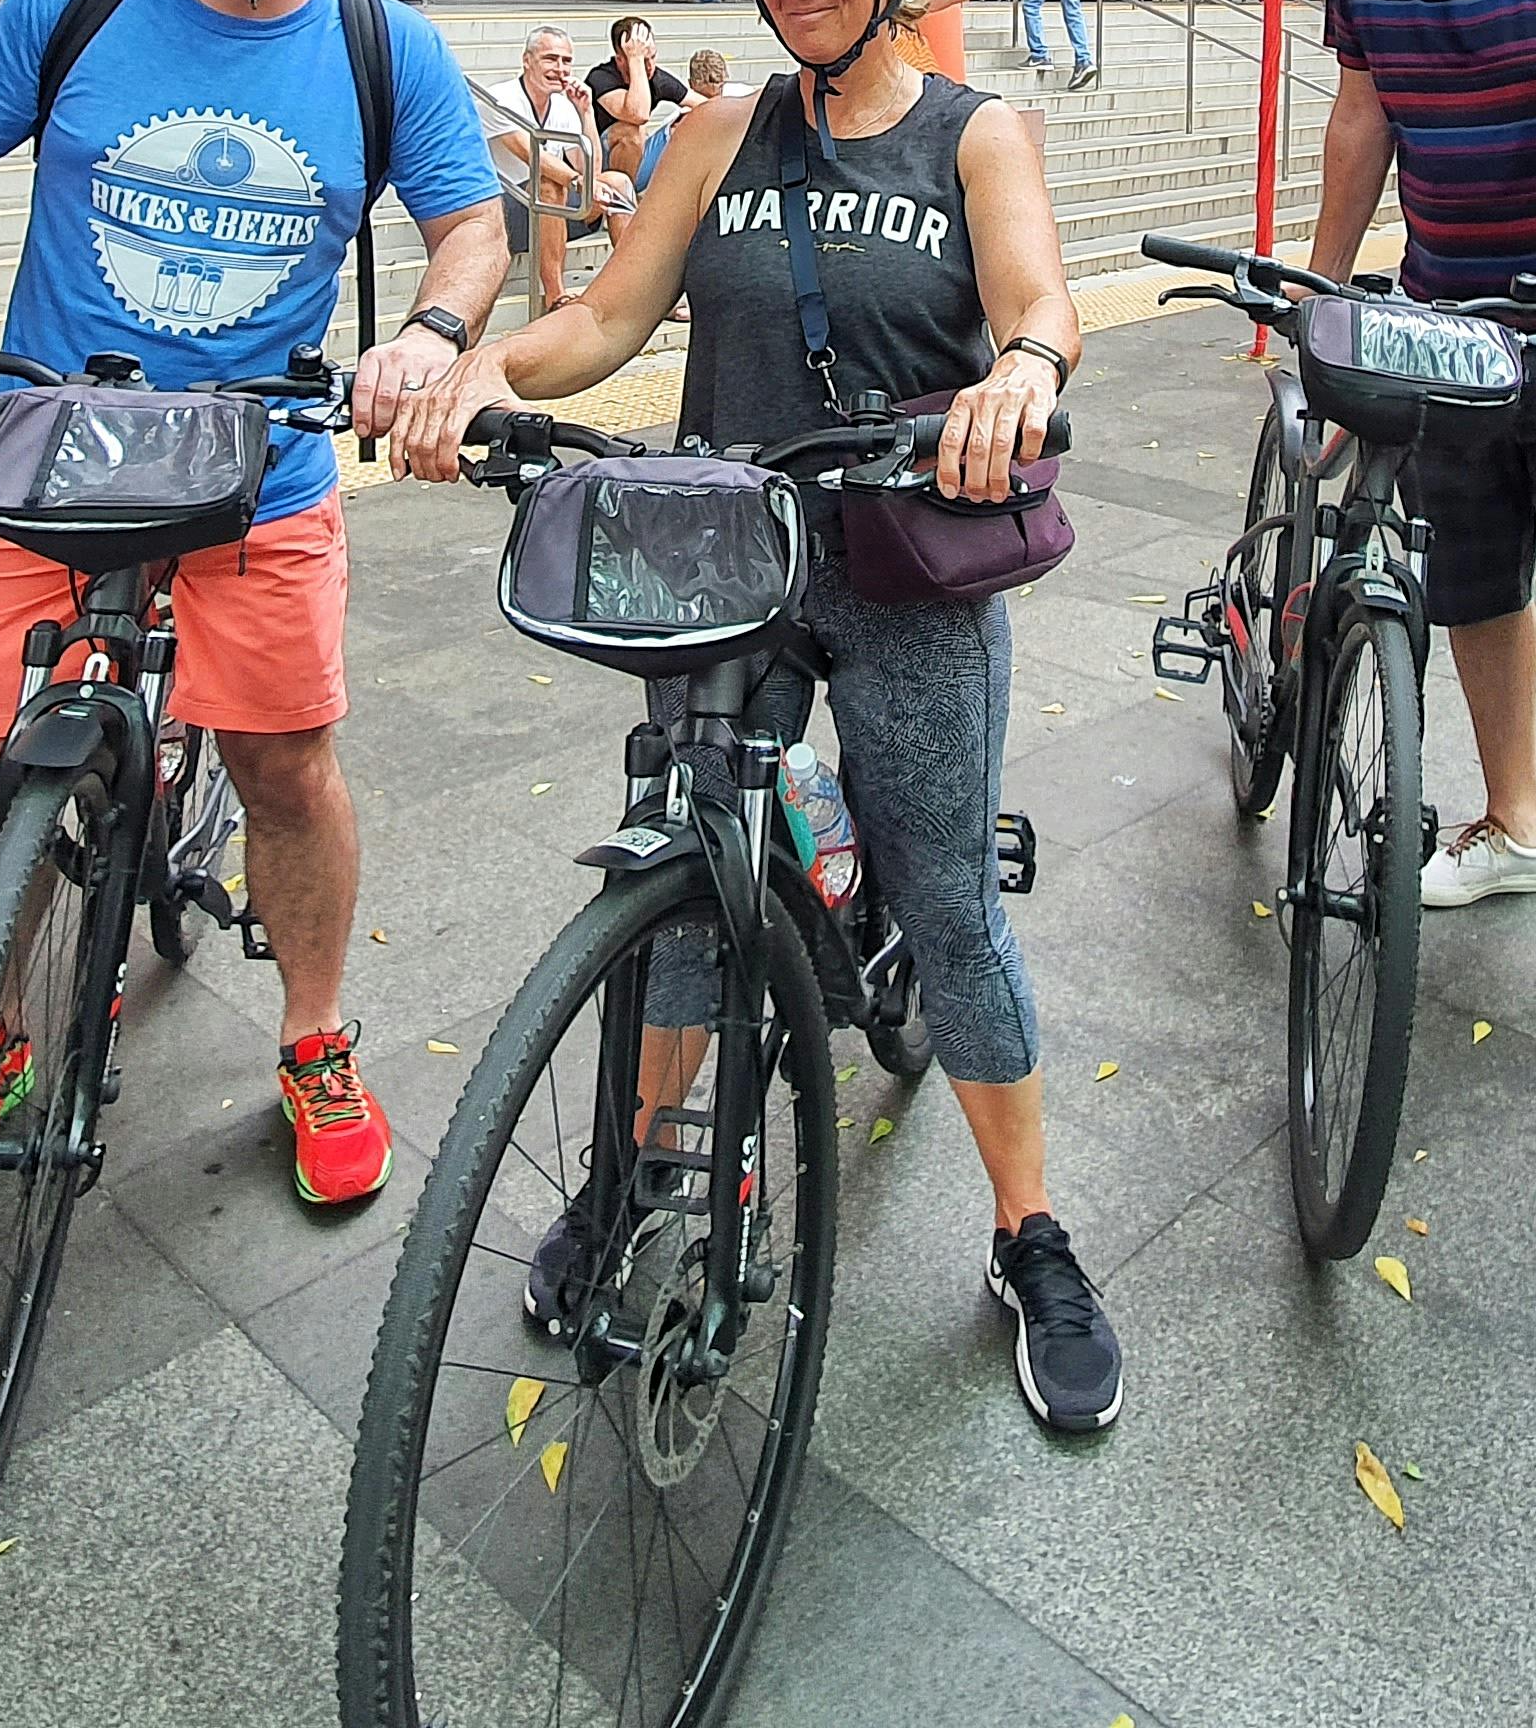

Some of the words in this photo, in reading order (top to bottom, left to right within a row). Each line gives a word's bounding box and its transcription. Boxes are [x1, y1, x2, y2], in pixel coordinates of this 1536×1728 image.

[92, 177, 189, 234] BIKES
[188, 207, 213, 234] &
[210, 206, 321, 247] BEERS
